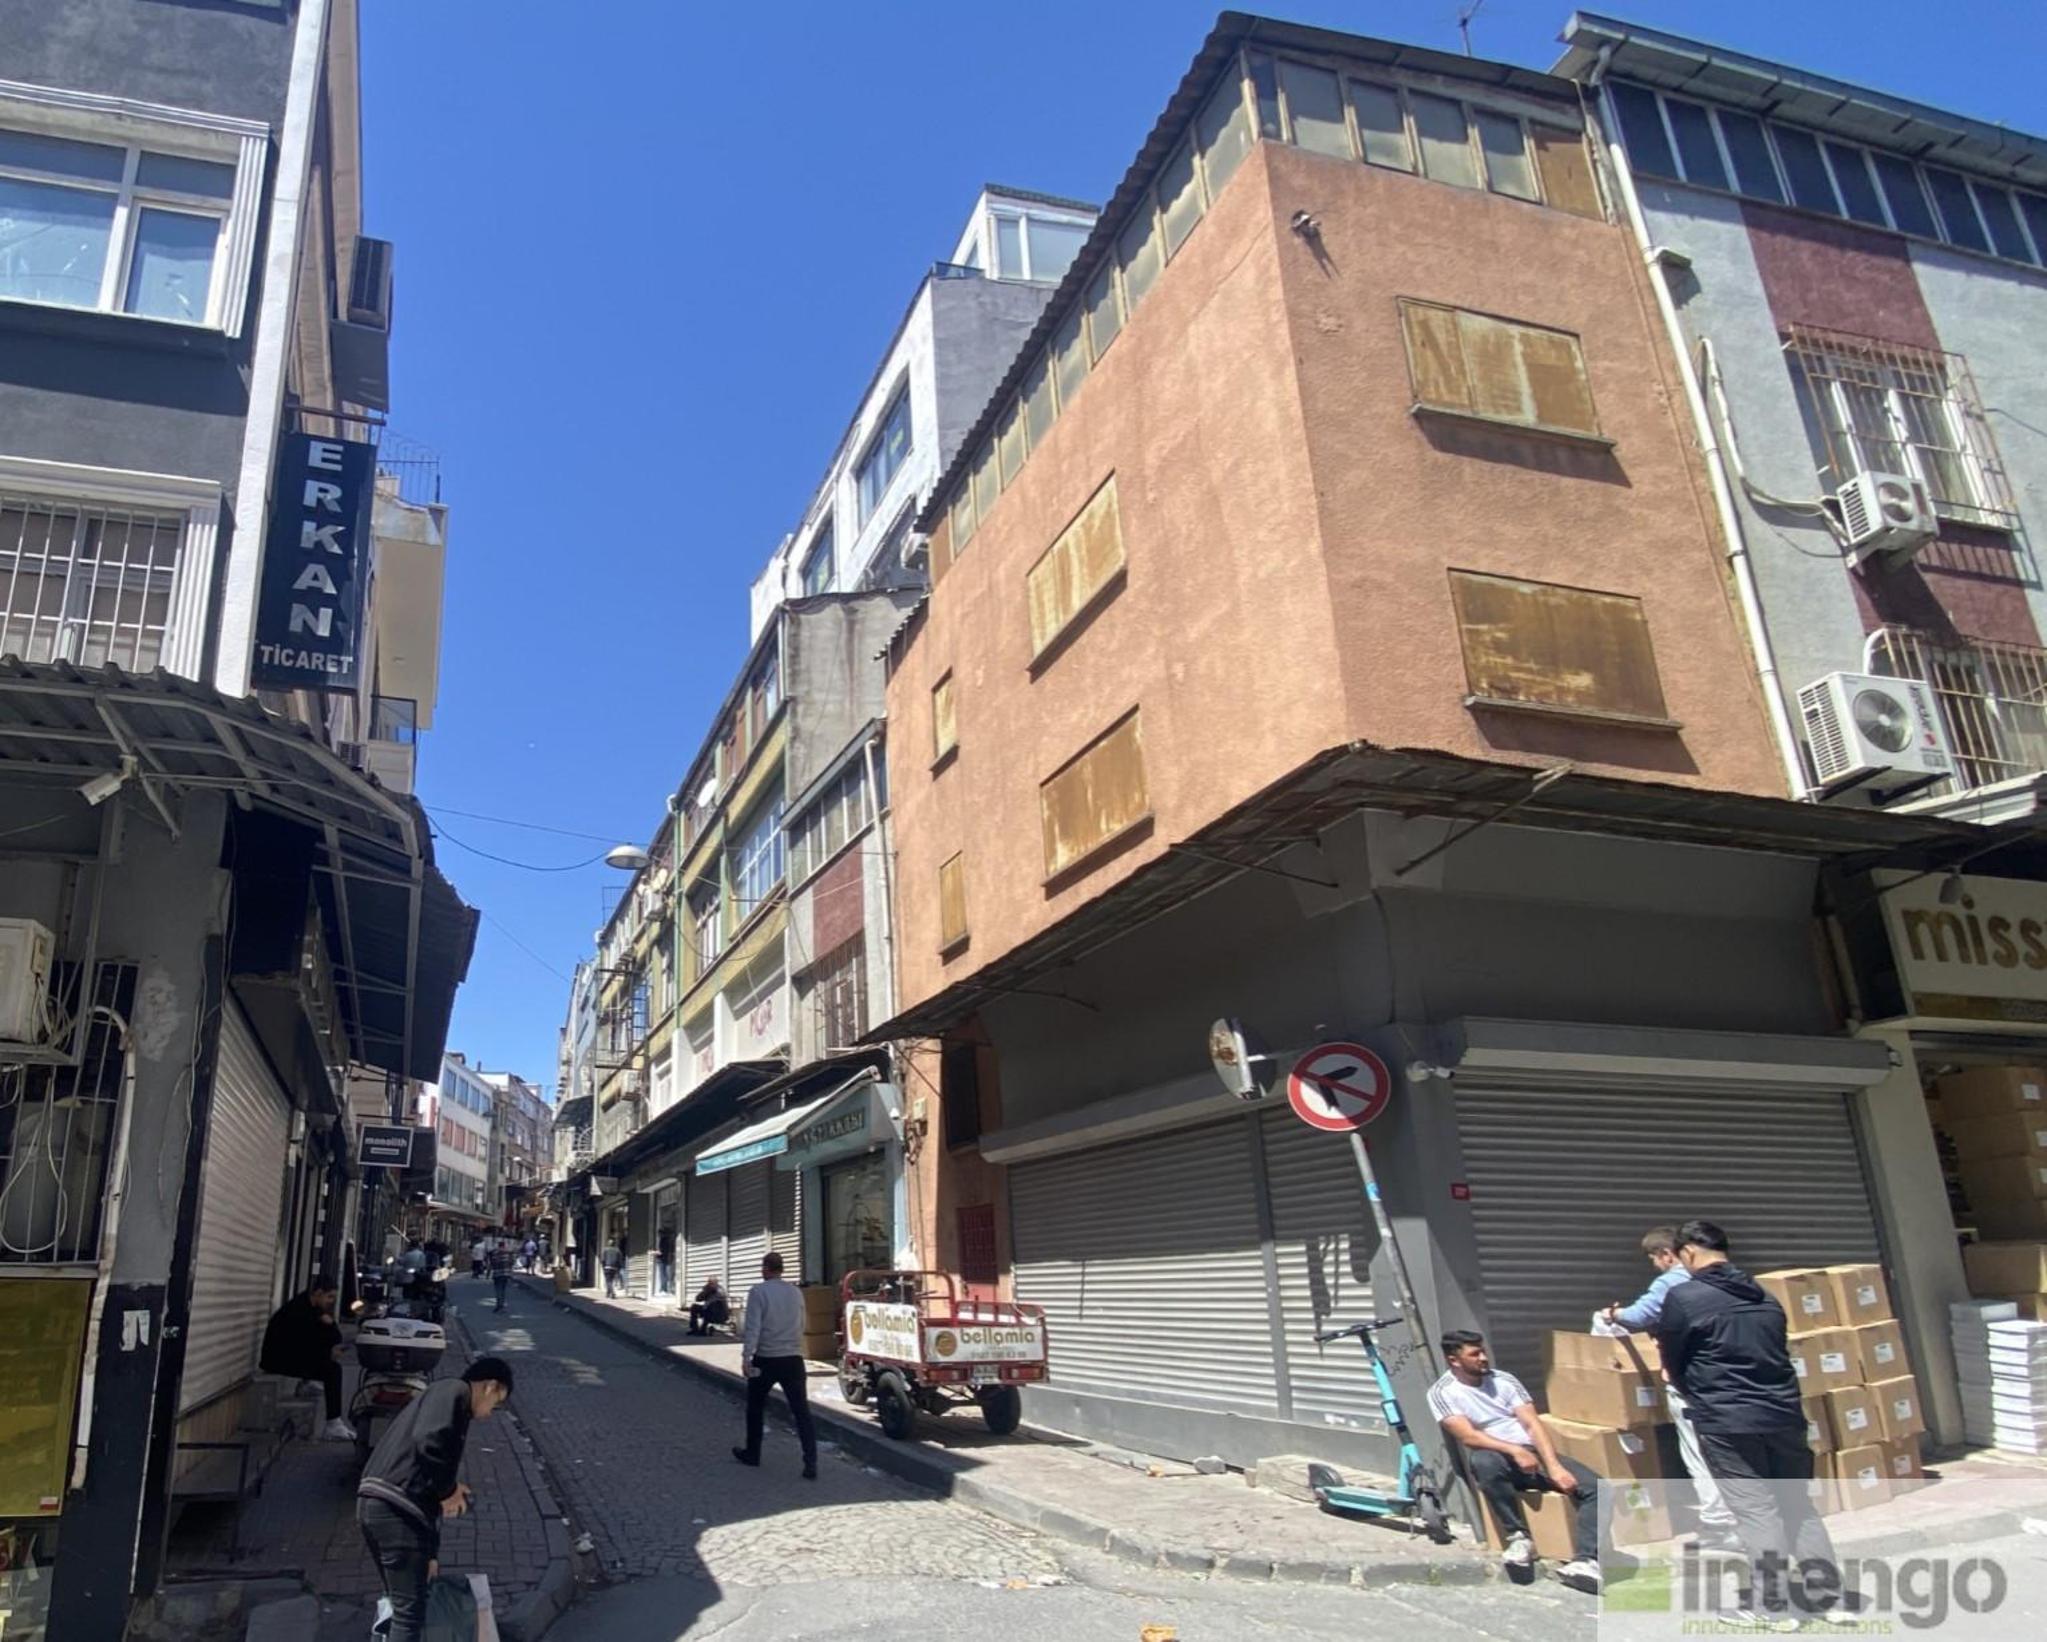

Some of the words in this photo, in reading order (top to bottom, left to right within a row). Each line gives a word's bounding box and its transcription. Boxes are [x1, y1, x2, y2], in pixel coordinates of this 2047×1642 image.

[289, 440, 346, 637] ERKAN
[260, 643, 354, 674] TİCARET
[1901, 893, 2047, 971] miss
[960, 1327, 1035, 1344] bellamia
